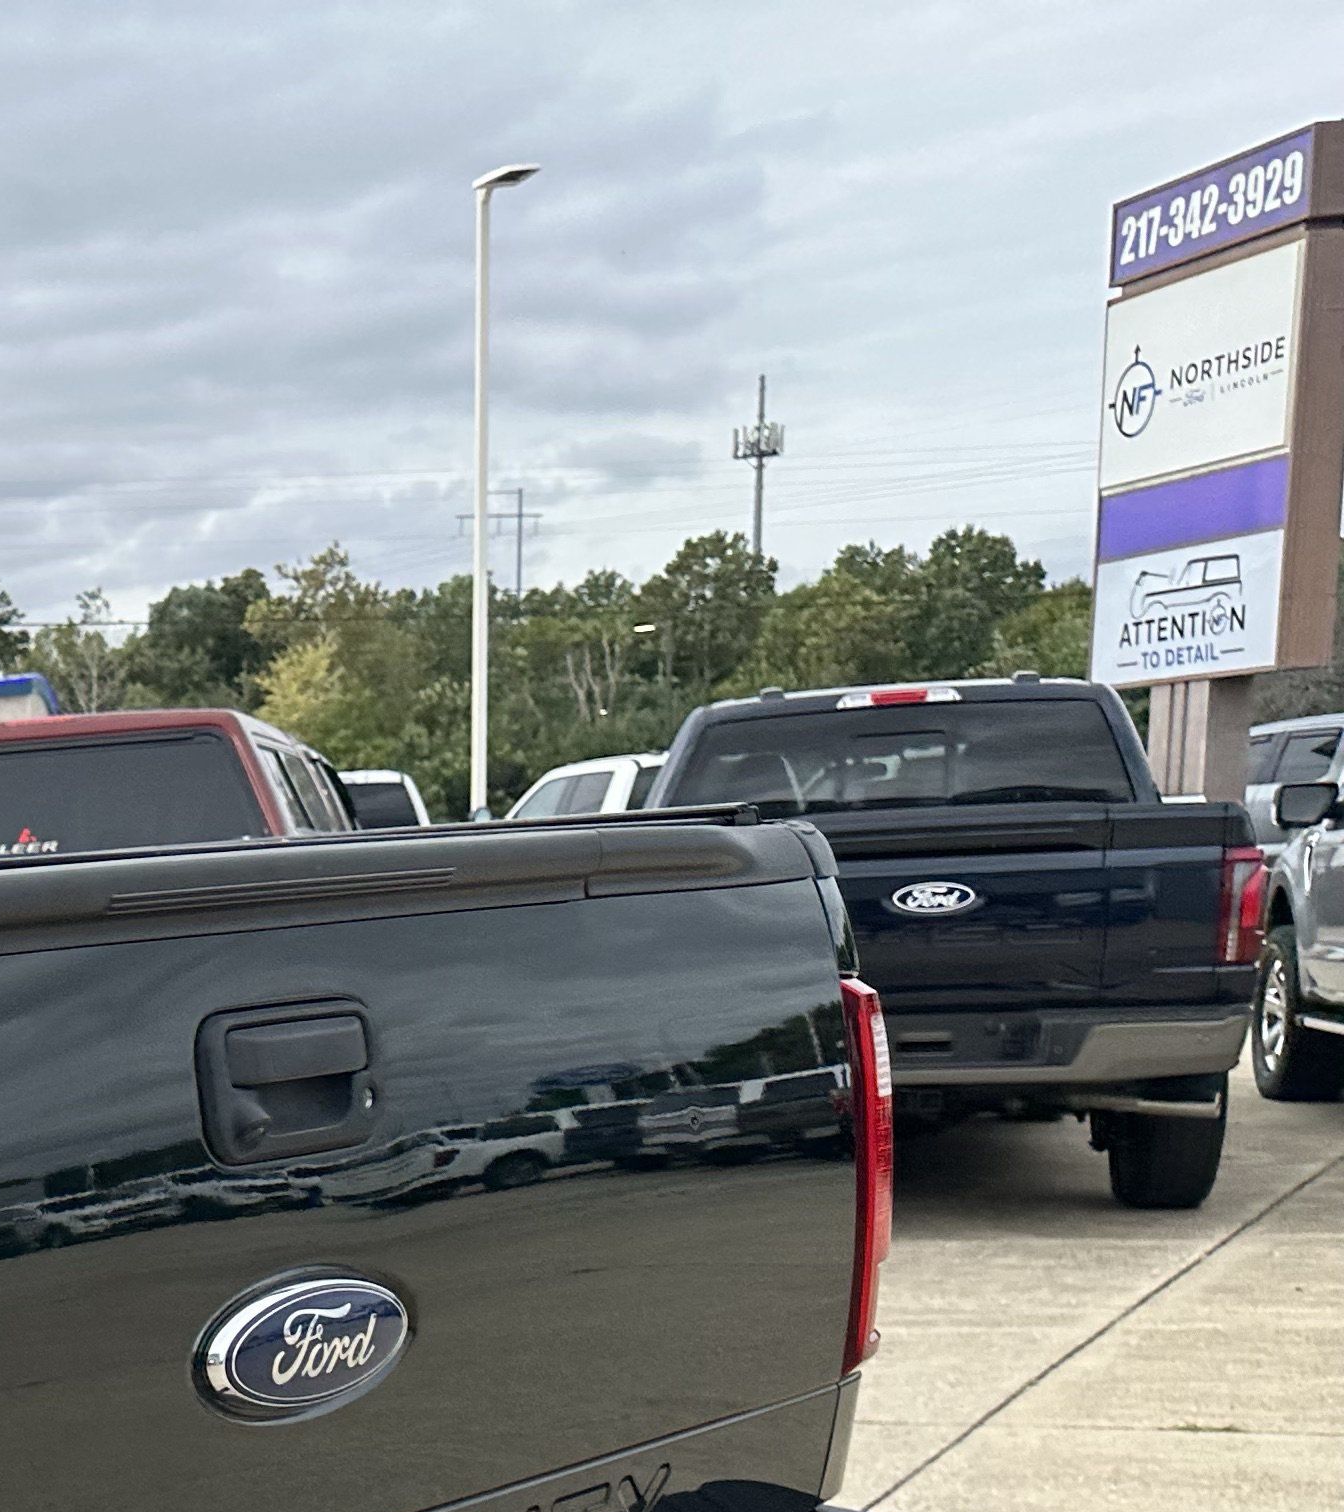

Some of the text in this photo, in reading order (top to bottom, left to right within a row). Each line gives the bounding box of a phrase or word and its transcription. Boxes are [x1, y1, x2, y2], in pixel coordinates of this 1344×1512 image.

[1120, 150, 1304, 266] 217-342-3929
[1170, 335, 1286, 390] NORTHSIDE
[1118, 603, 1247, 649] ATTENTION
[1141, 642, 1220, 669] TO DETAIL
[271, 1301, 378, 1386] Ford
